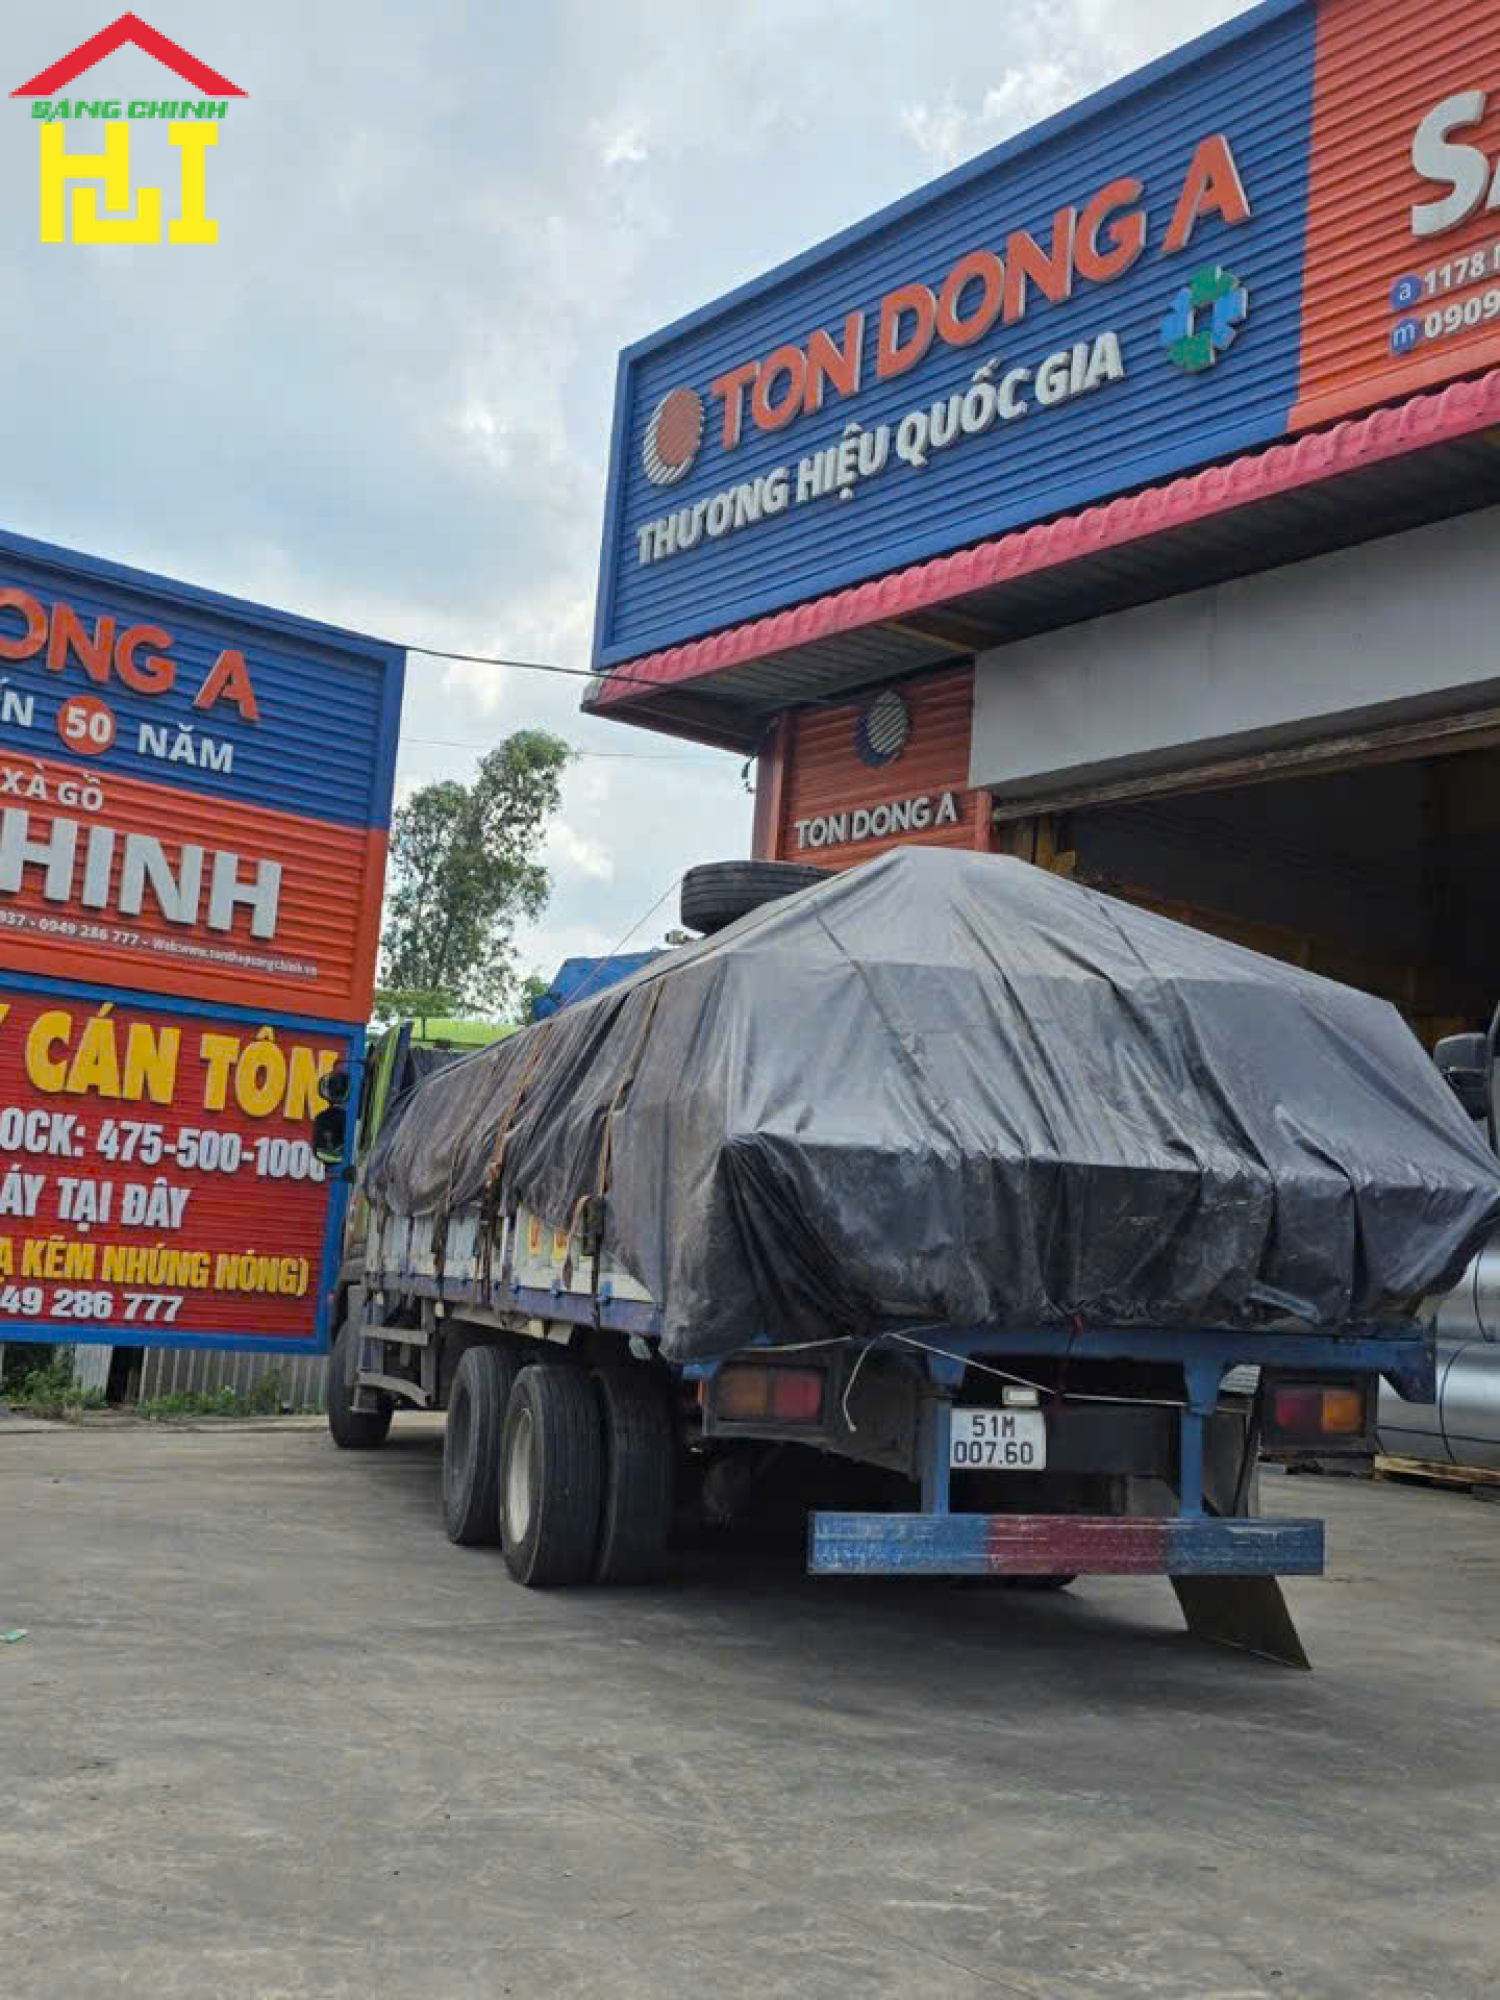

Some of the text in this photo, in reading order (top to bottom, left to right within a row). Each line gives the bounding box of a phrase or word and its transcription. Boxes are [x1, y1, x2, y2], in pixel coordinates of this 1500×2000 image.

[1411, 89, 1500, 237] S
[710, 134, 1250, 450] TON DONG A
[1425, 251, 1486, 295] 1178
[636, 331, 1124, 564] THƯƠNG HIỆU QUỐC GIA
[193, 649, 259, 721] A
[66, 706, 111, 743] 50
[137, 722, 234, 774] NĂM
[0, 763, 104, 812] XÀ GỒ
[794, 792, 957, 848] TON DONG A
[0, 807, 283, 940] HINH
[25, 1002, 340, 1120] CÁN TÔN
[57, 1176, 114, 1232] TẠI
[120, 1177, 191, 1229] ĐÂY
[21, 1235, 97, 1281] KẼM
[101, 1242, 211, 1290] NHÚNG
[214, 1249, 310, 1297] NÓNG)
[0, 1285, 184, 1323] 49 286 777
[953, 1441, 1034, 1464] 007.60
[972, 1414, 1016, 1438] 51M
